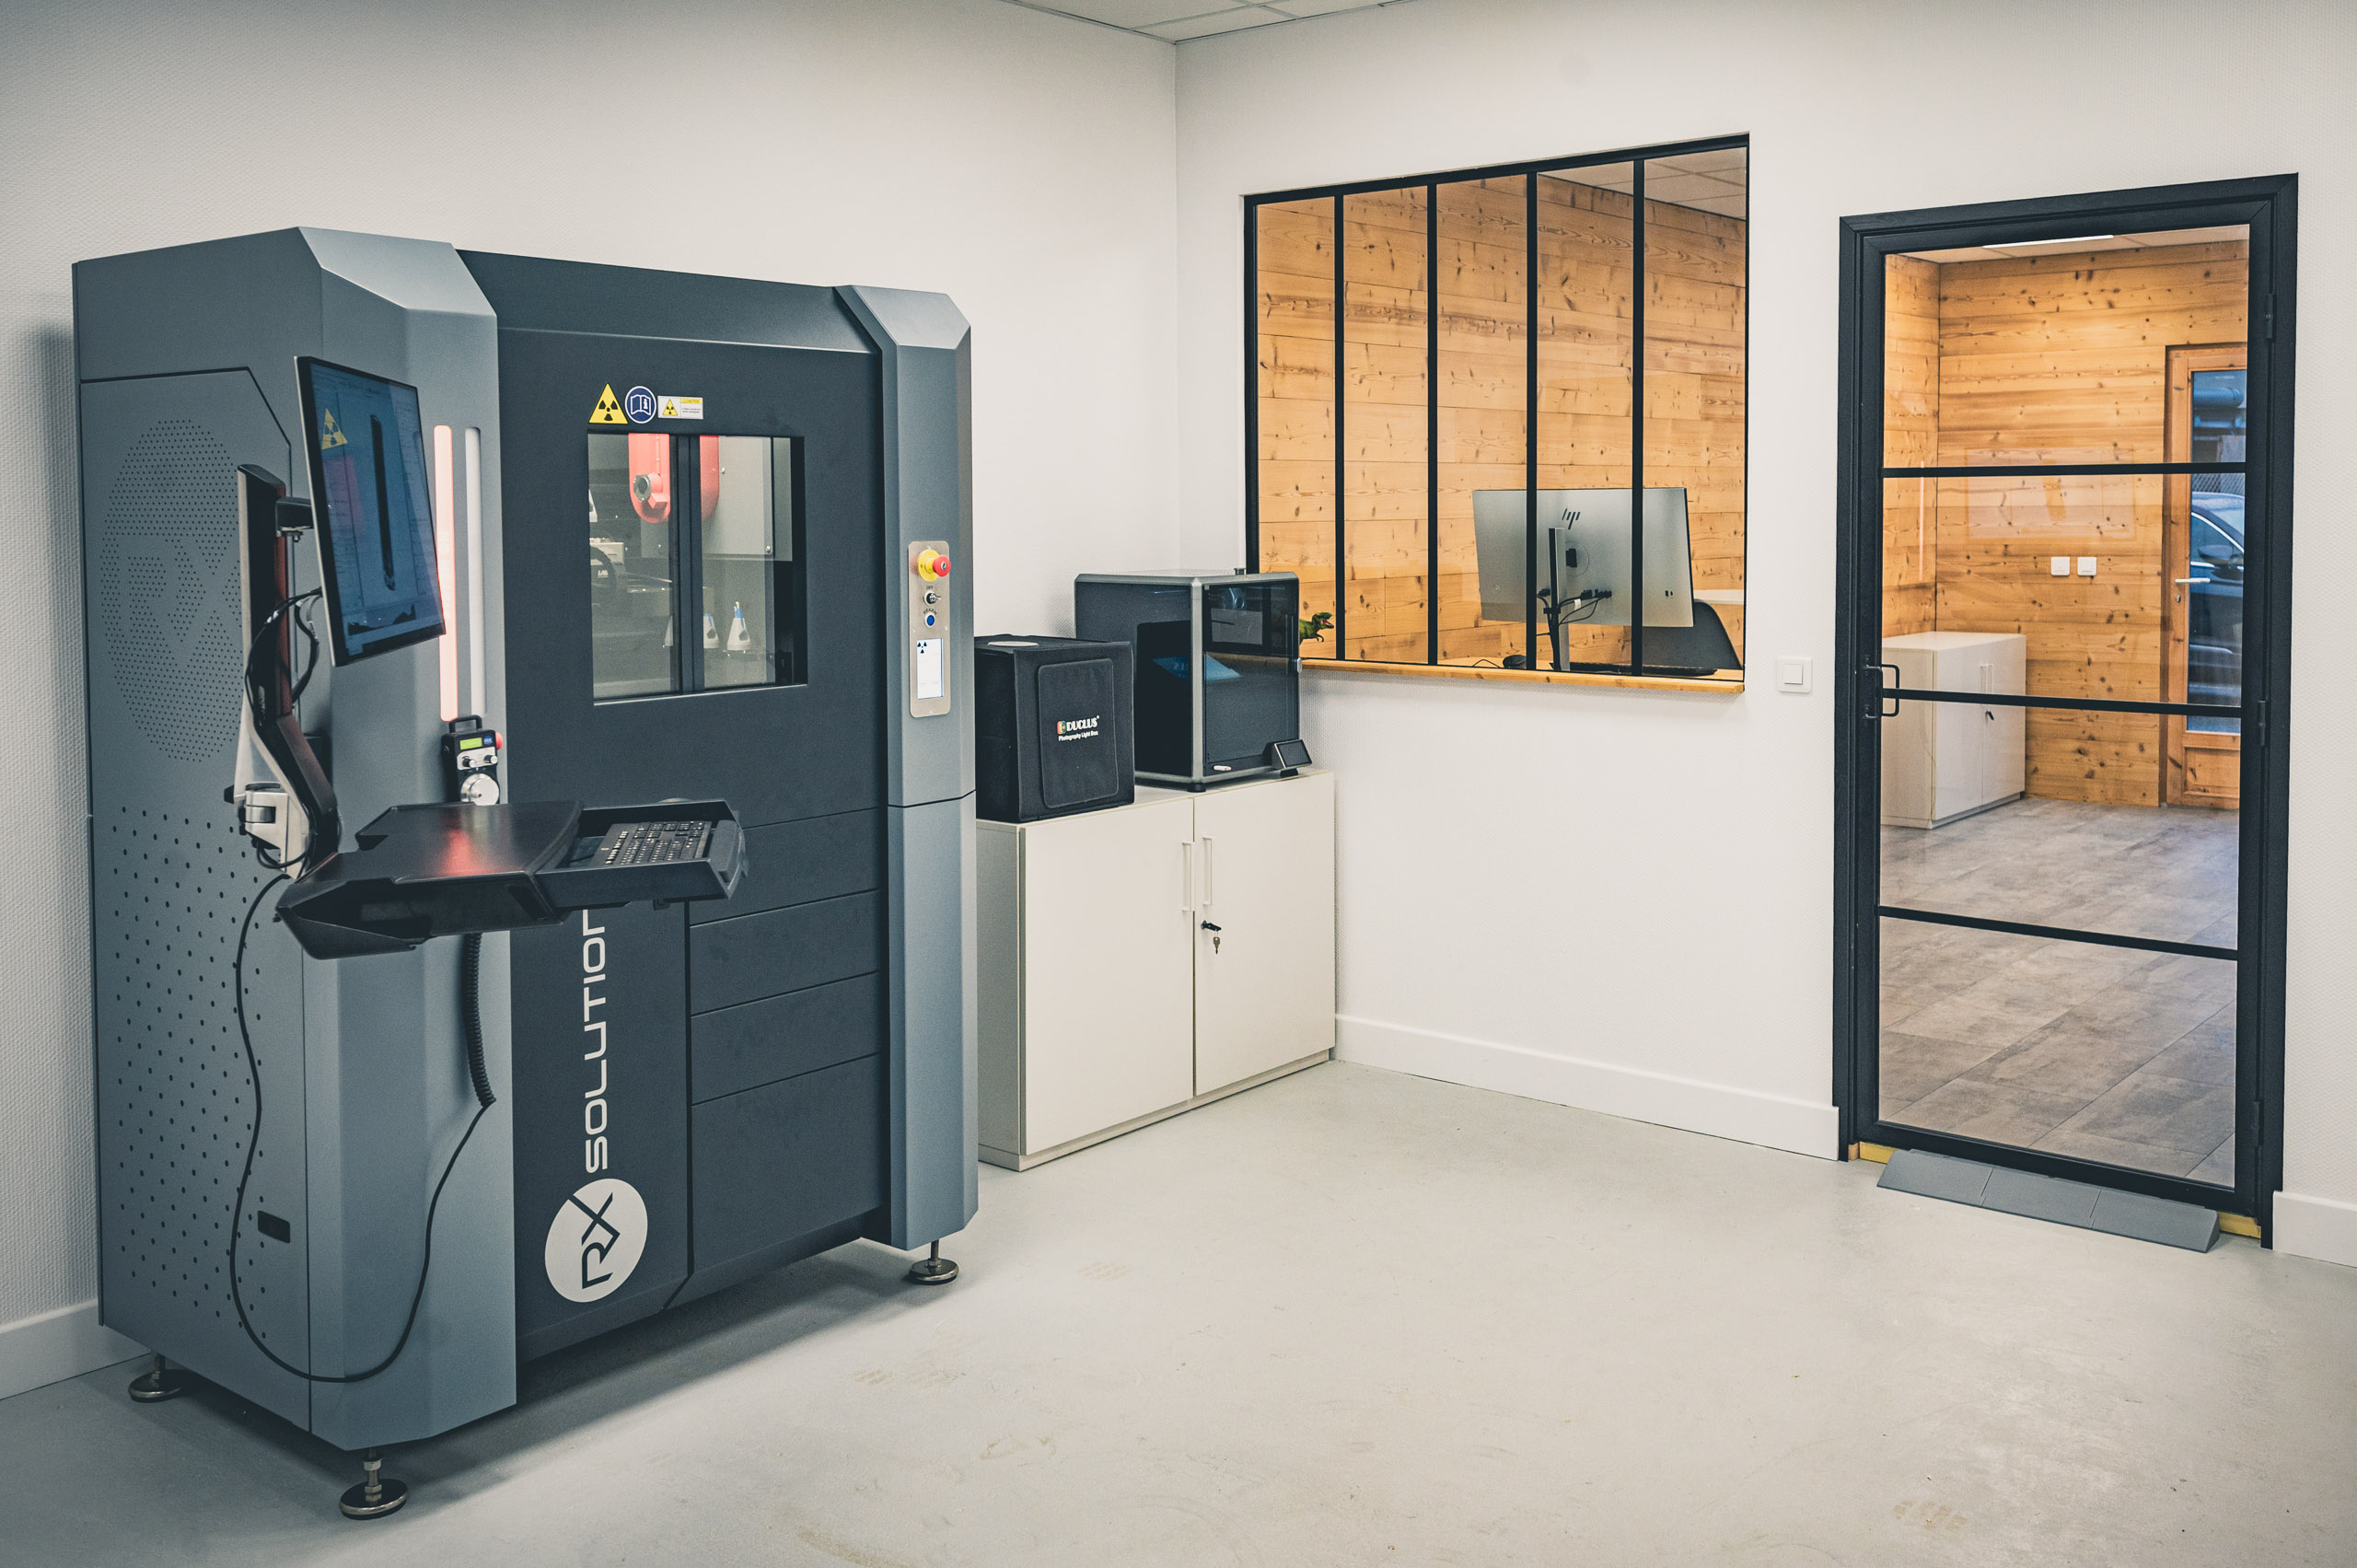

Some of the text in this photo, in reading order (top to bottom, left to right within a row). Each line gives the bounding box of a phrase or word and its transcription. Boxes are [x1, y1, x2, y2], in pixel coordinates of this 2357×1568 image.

[1562, 508, 1581, 530] hp
[1059, 733, 1082, 742] Photography
[568, 1192, 621, 1290] RX
